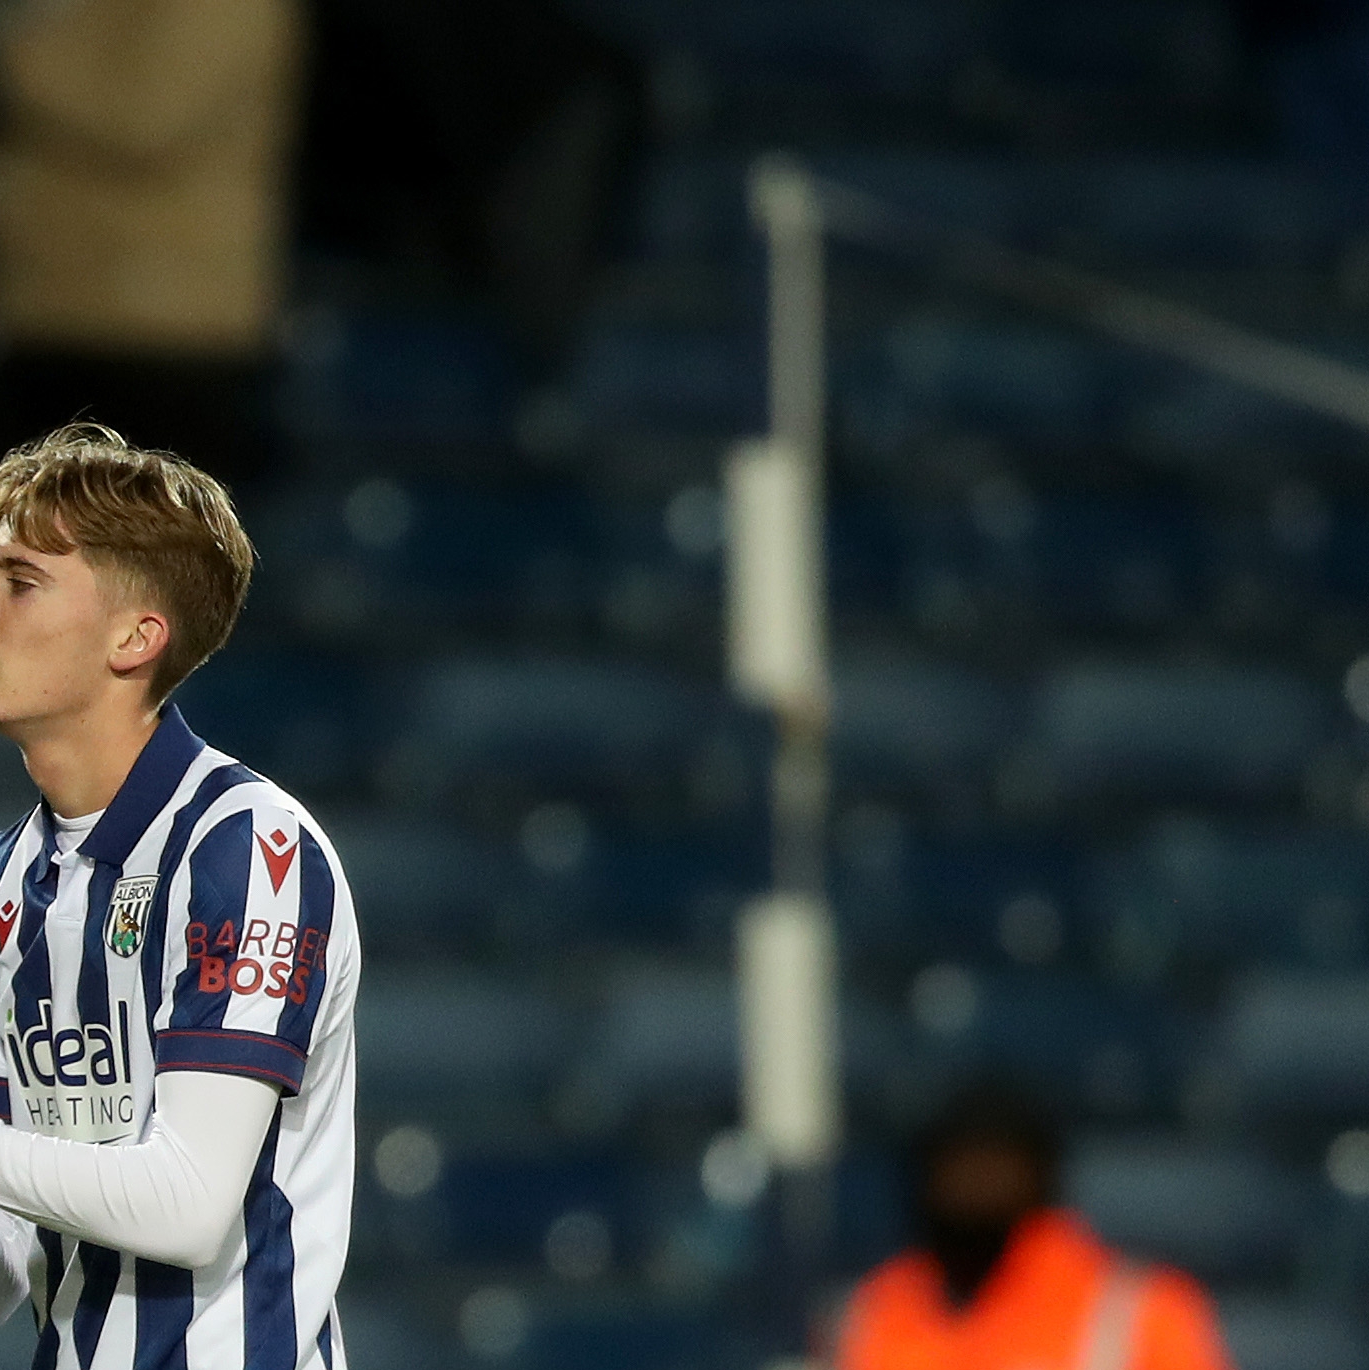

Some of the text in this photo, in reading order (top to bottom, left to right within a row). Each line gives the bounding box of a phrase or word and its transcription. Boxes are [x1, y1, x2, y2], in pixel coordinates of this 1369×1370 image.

[114, 886, 154, 901] ALBION
[197, 955, 310, 1005] BOSS
[6, 999, 131, 1088] ideal
